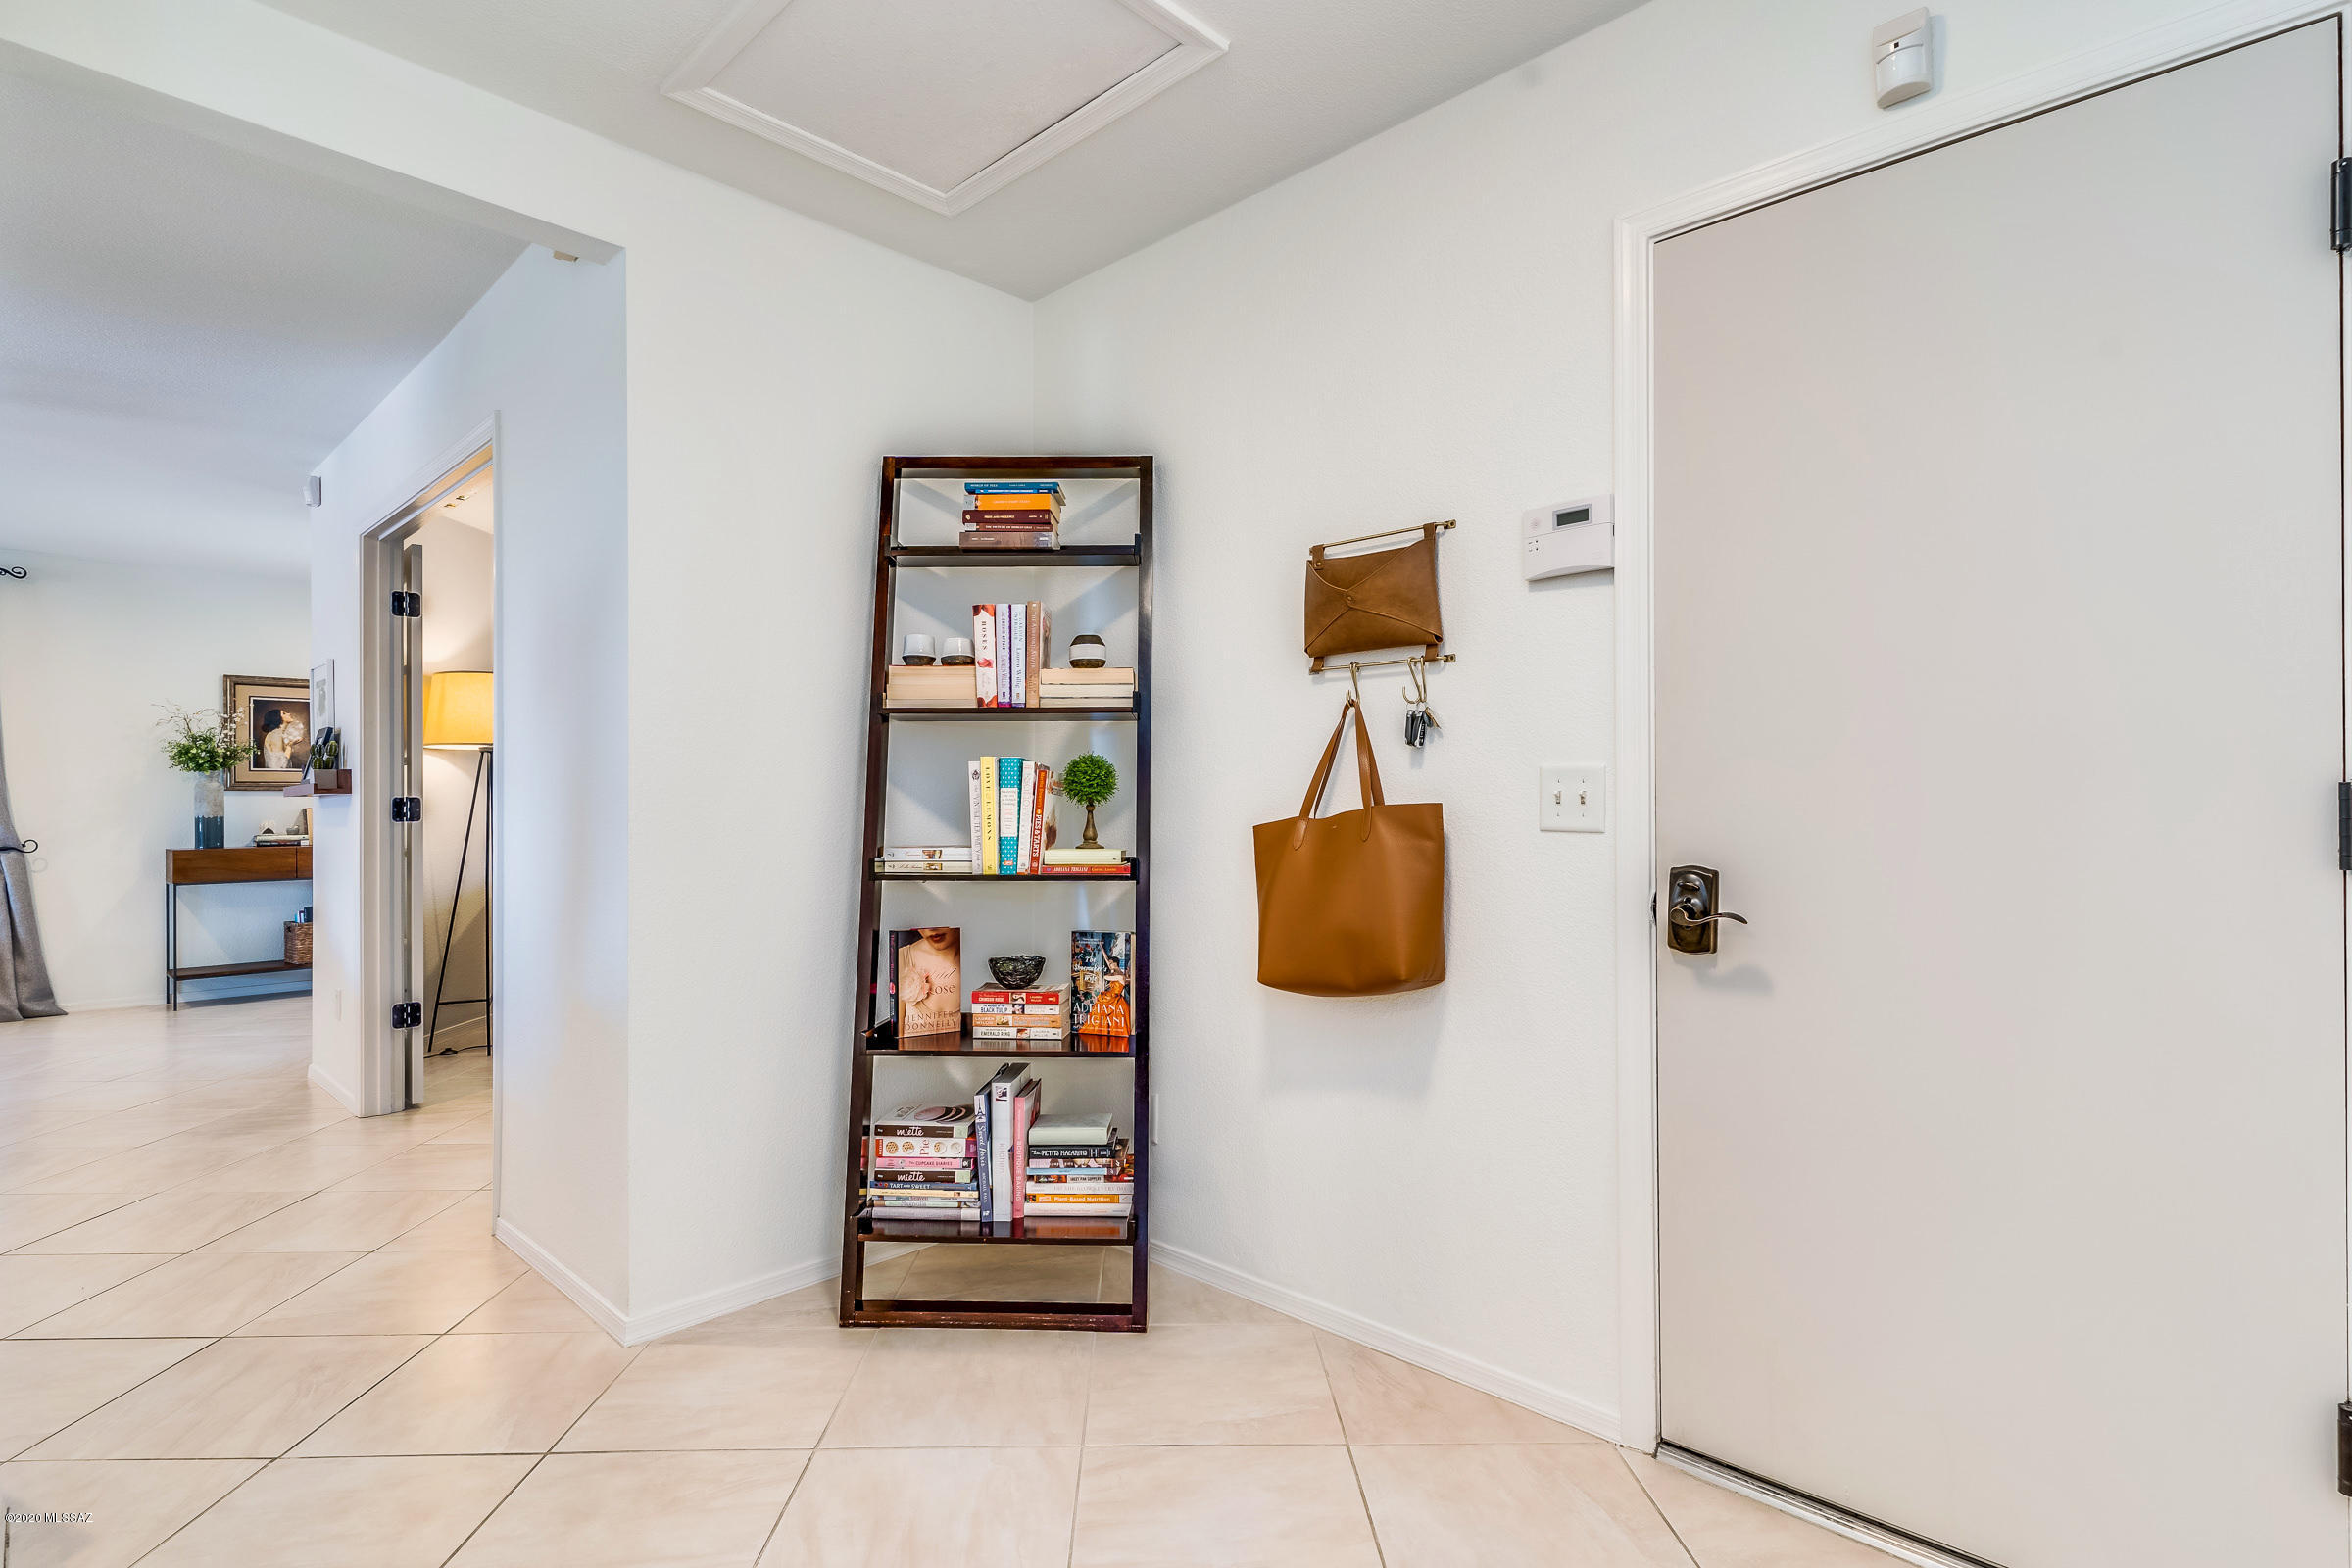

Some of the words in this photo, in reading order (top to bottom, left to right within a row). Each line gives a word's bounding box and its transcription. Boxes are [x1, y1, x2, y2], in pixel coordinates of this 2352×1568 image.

[1032, 834, 1041, 858] TARTS
[1073, 1002, 1125, 1015] ADRIANA
[907, 1010, 955, 1022] JENNIFER
[1073, 1013, 1125, 1028] TRIGIANI
[905, 1019, 956, 1031] DONNELLY
[896, 1126, 924, 1137] miette
[919, 1139, 930, 1155] Pie
[897, 1171, 926, 1182] miette
